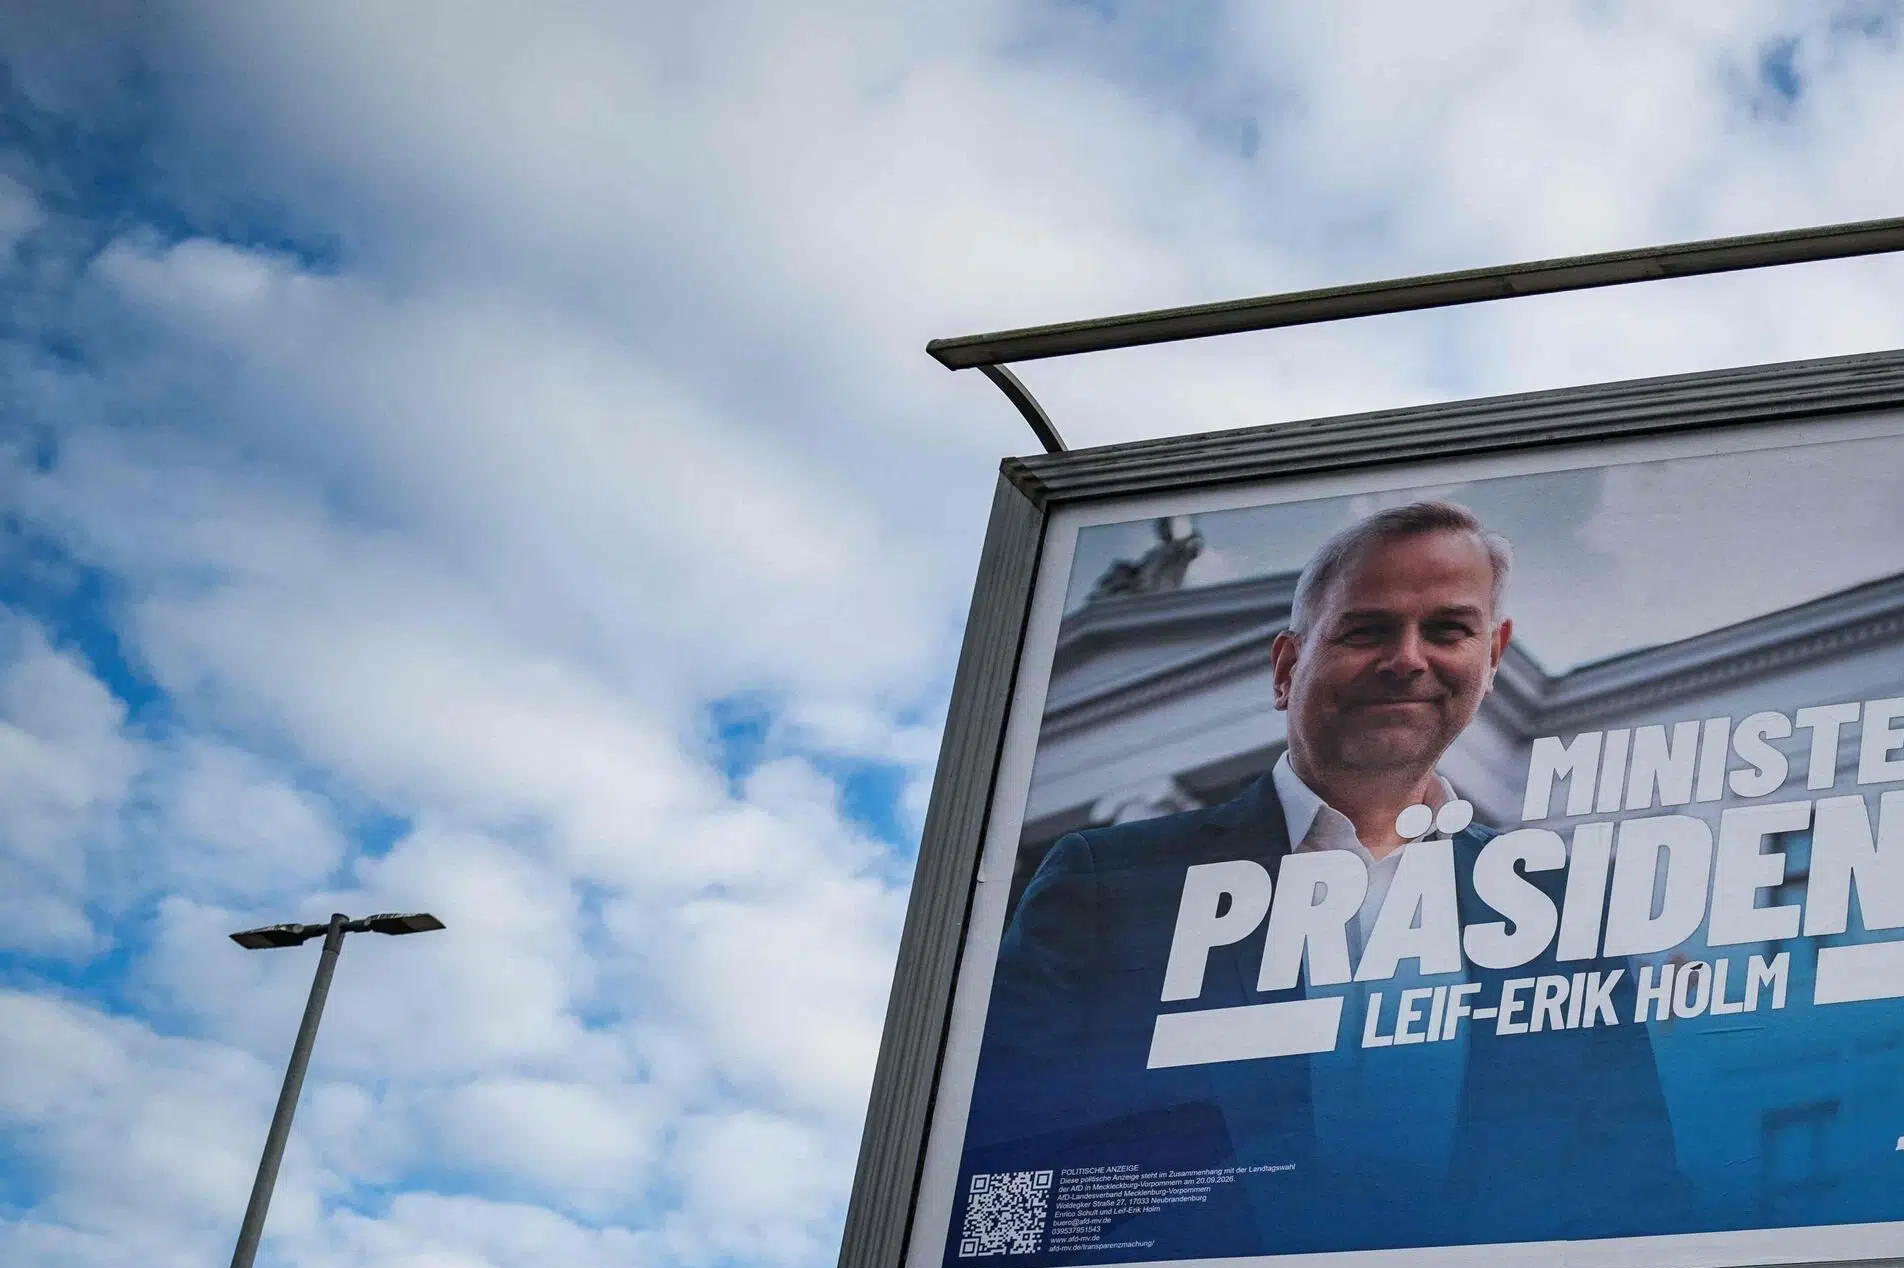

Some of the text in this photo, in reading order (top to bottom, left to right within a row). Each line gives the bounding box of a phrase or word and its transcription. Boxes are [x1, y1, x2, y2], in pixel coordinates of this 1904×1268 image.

[1361, 952, 1791, 1049] LEIF-ERIK HOLM
[1060, 1177, 1079, 1185] Diese
[1080, 1175, 1112, 1184] politische
[1112, 1174, 1140, 1183] Anzeige
[1141, 1172, 1158, 1180] steht
[1169, 1168, 1223, 1178] Zusammenhang
[1224, 1166, 1235, 1174] mit
[1236, 1165, 1247, 1174] der
[1248, 1163, 1296, 1173] Landtagswahl
[1061, 1164, 1140, 1176] POLITISCHE ANZEIGE
[1057, 1186, 1211, 1201] AfD-Landesverband Mecklenburg-Vorpommern
[1059, 1185, 1069, 1193] der
[1070, 1184, 1083, 1192] AfD
[1084, 1183, 1092, 1191] in
[1056, 1194, 1207, 1210] Woldegker Straße 27, 17033 Neubrandenburg
[1054, 1210, 1076, 1218] Enrico
[1077, 1209, 1099, 1217] Schult
[1113, 1206, 1141, 1215] Leif-Erik
[1142, 1205, 1161, 1213] Holm
[1053, 1217, 1112, 1227] buero@afd-mv.de
[1050, 1235, 1100, 1244] www.afd-mv.de
